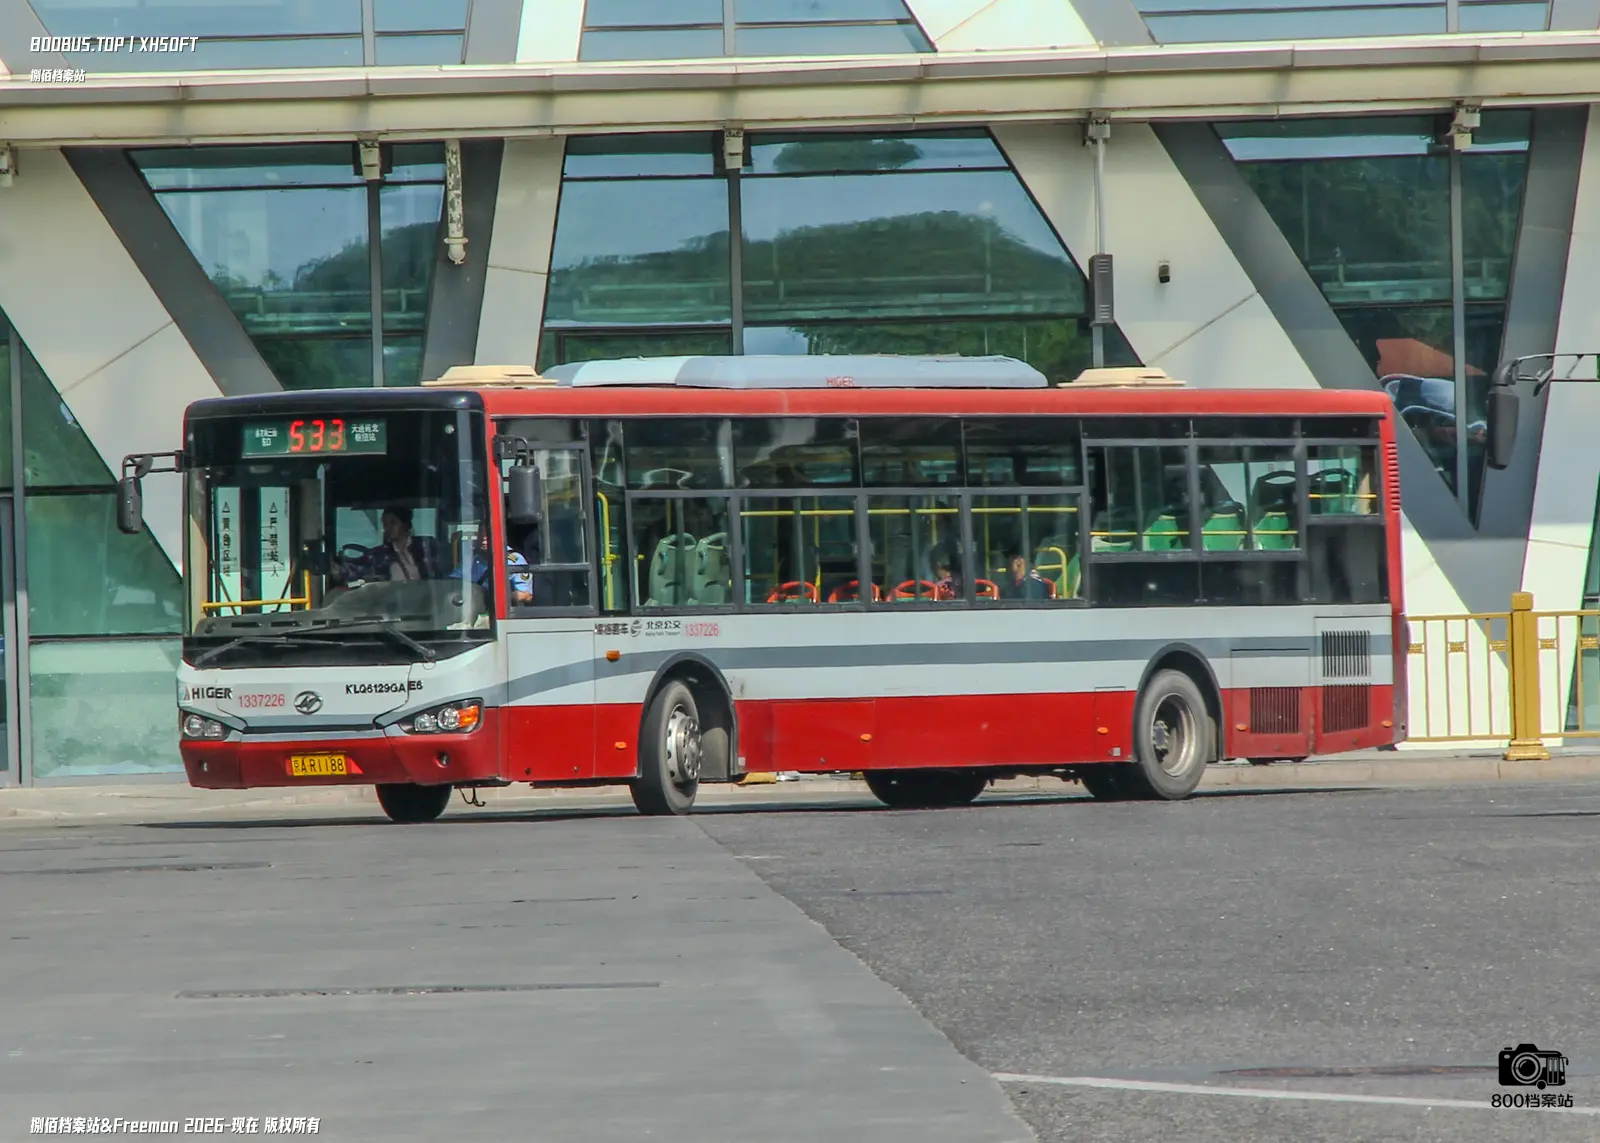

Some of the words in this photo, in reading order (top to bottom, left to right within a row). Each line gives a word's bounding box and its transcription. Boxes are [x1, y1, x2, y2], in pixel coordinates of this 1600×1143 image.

[825, 376, 855, 387] HIGER
[289, 418, 344, 452] 533
[646, 620, 681, 629] 北京公交
[685, 623, 719, 637] 1337226
[191, 686, 233, 700] HIGER
[238, 693, 286, 708] 1337226
